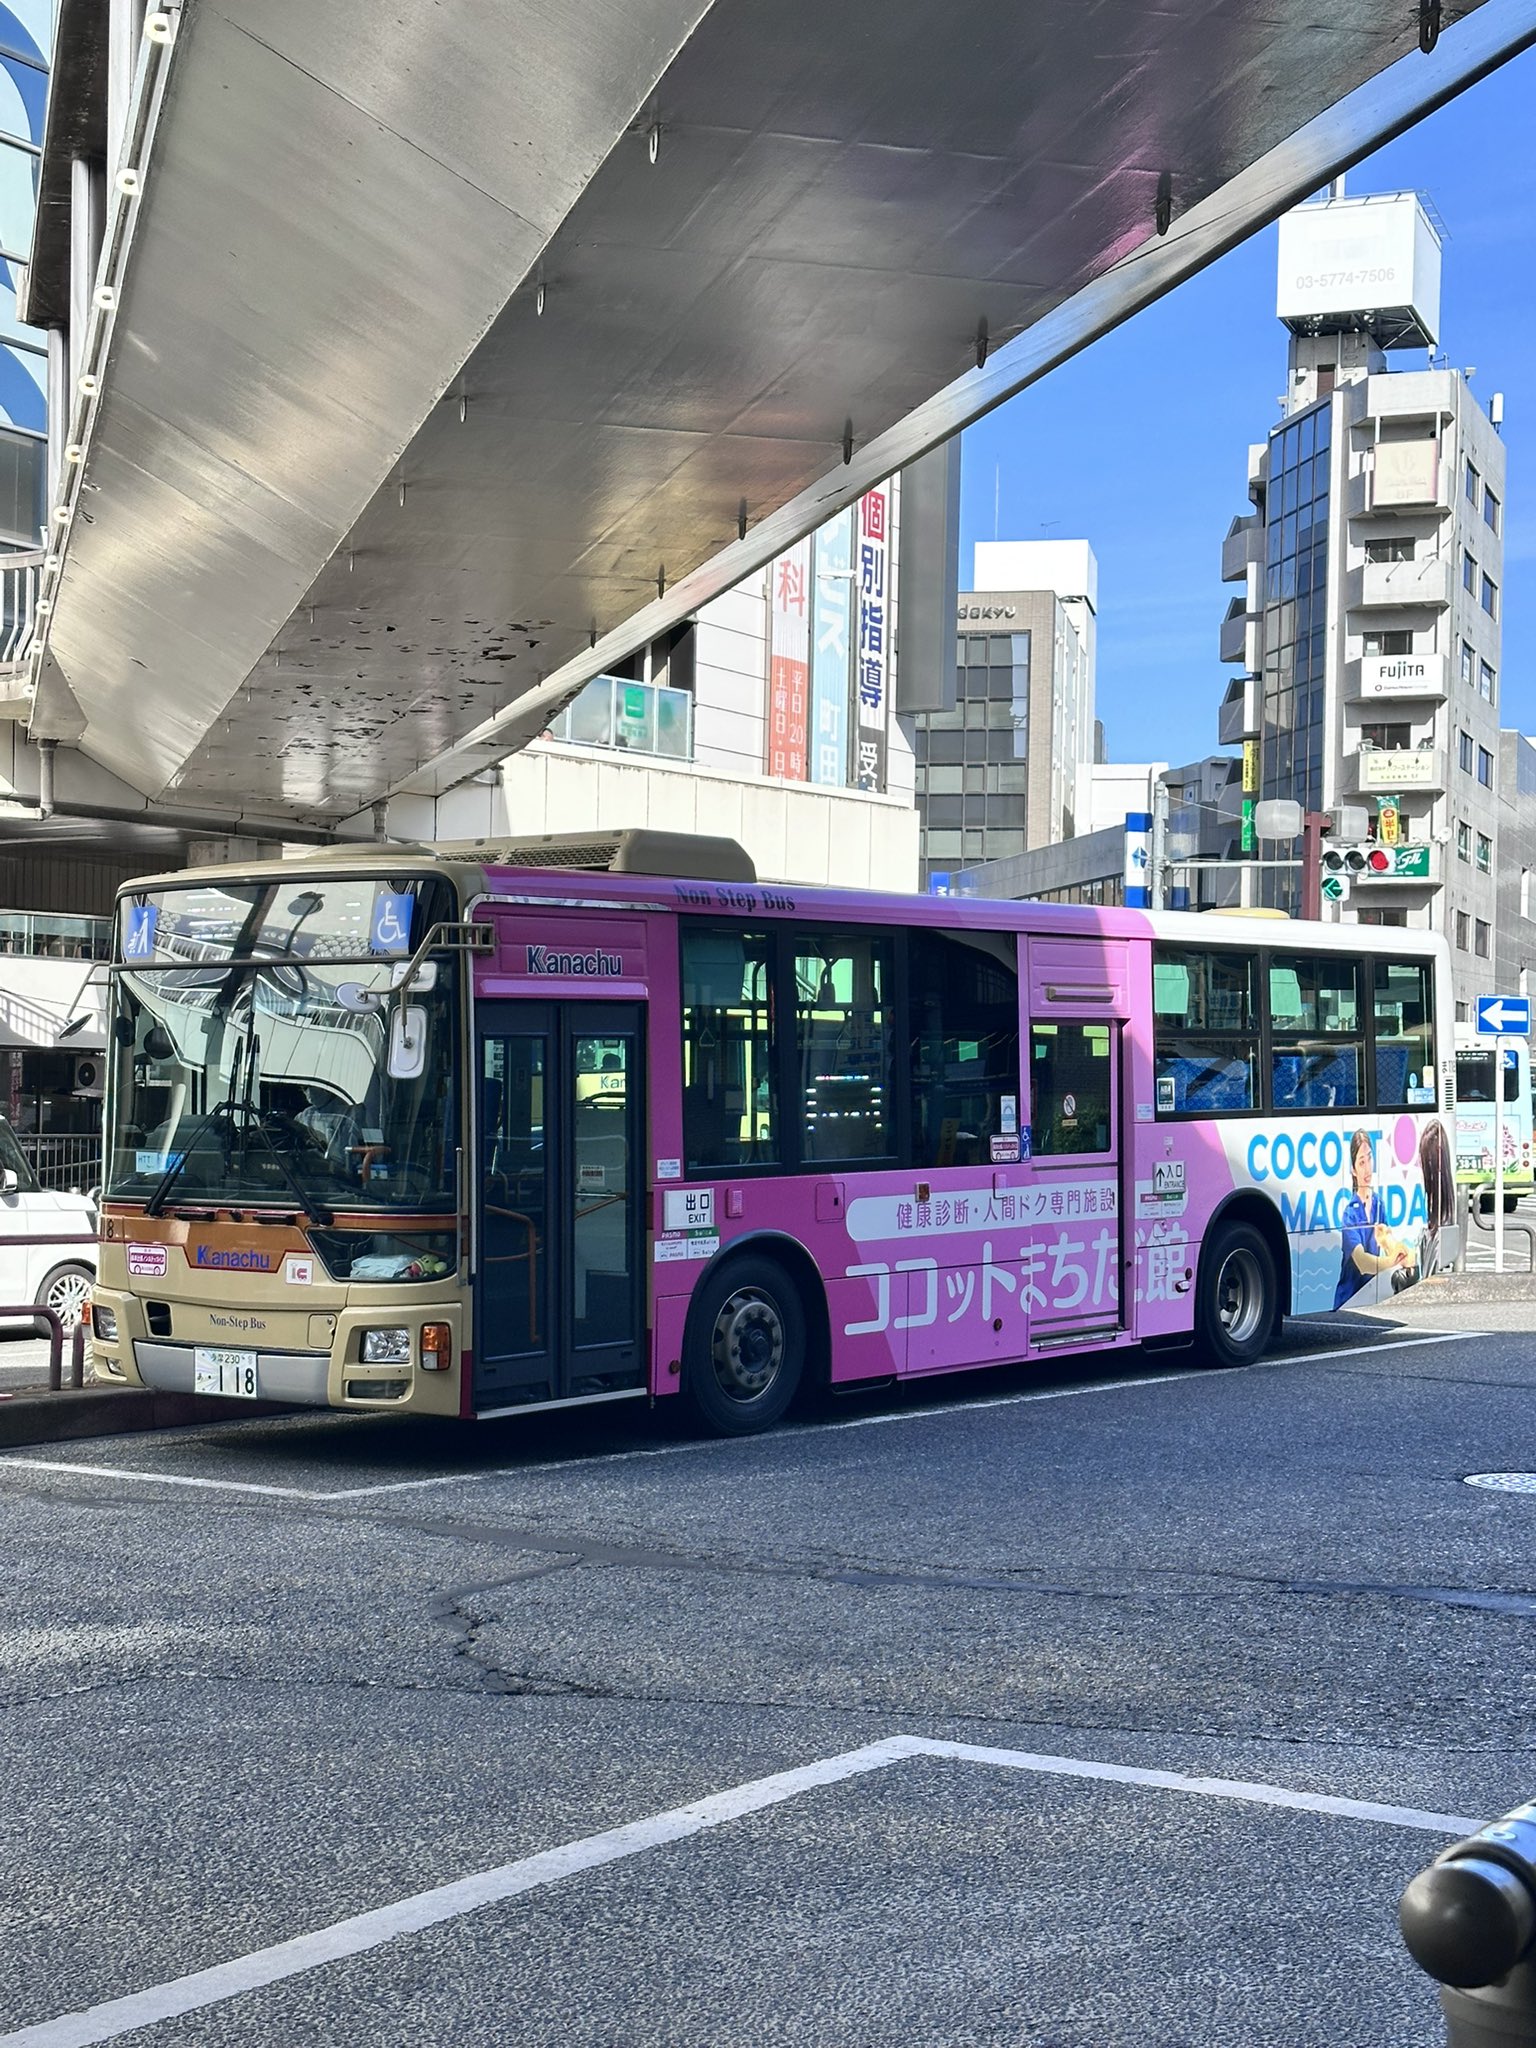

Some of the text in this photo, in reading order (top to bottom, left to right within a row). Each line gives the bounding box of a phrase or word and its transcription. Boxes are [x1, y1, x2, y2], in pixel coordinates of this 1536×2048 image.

[1296, 267, 1396, 289] 03-5774-7506
[779, 559, 805, 617] 科
[861, 490, 885, 710] 個別指導
[819, 696, 841, 783] 町田
[674, 884, 796, 912] Non Step Bus
[526, 945, 622, 977] Kanachu
[1166, 1164, 1183, 1178] 入口
[686, 1193, 709, 1211] 出口
[688, 1213, 707, 1224] EXIT
[197, 1245, 270, 1269] Kanachu
[209, 1313, 267, 1331] Non-Step Bus
